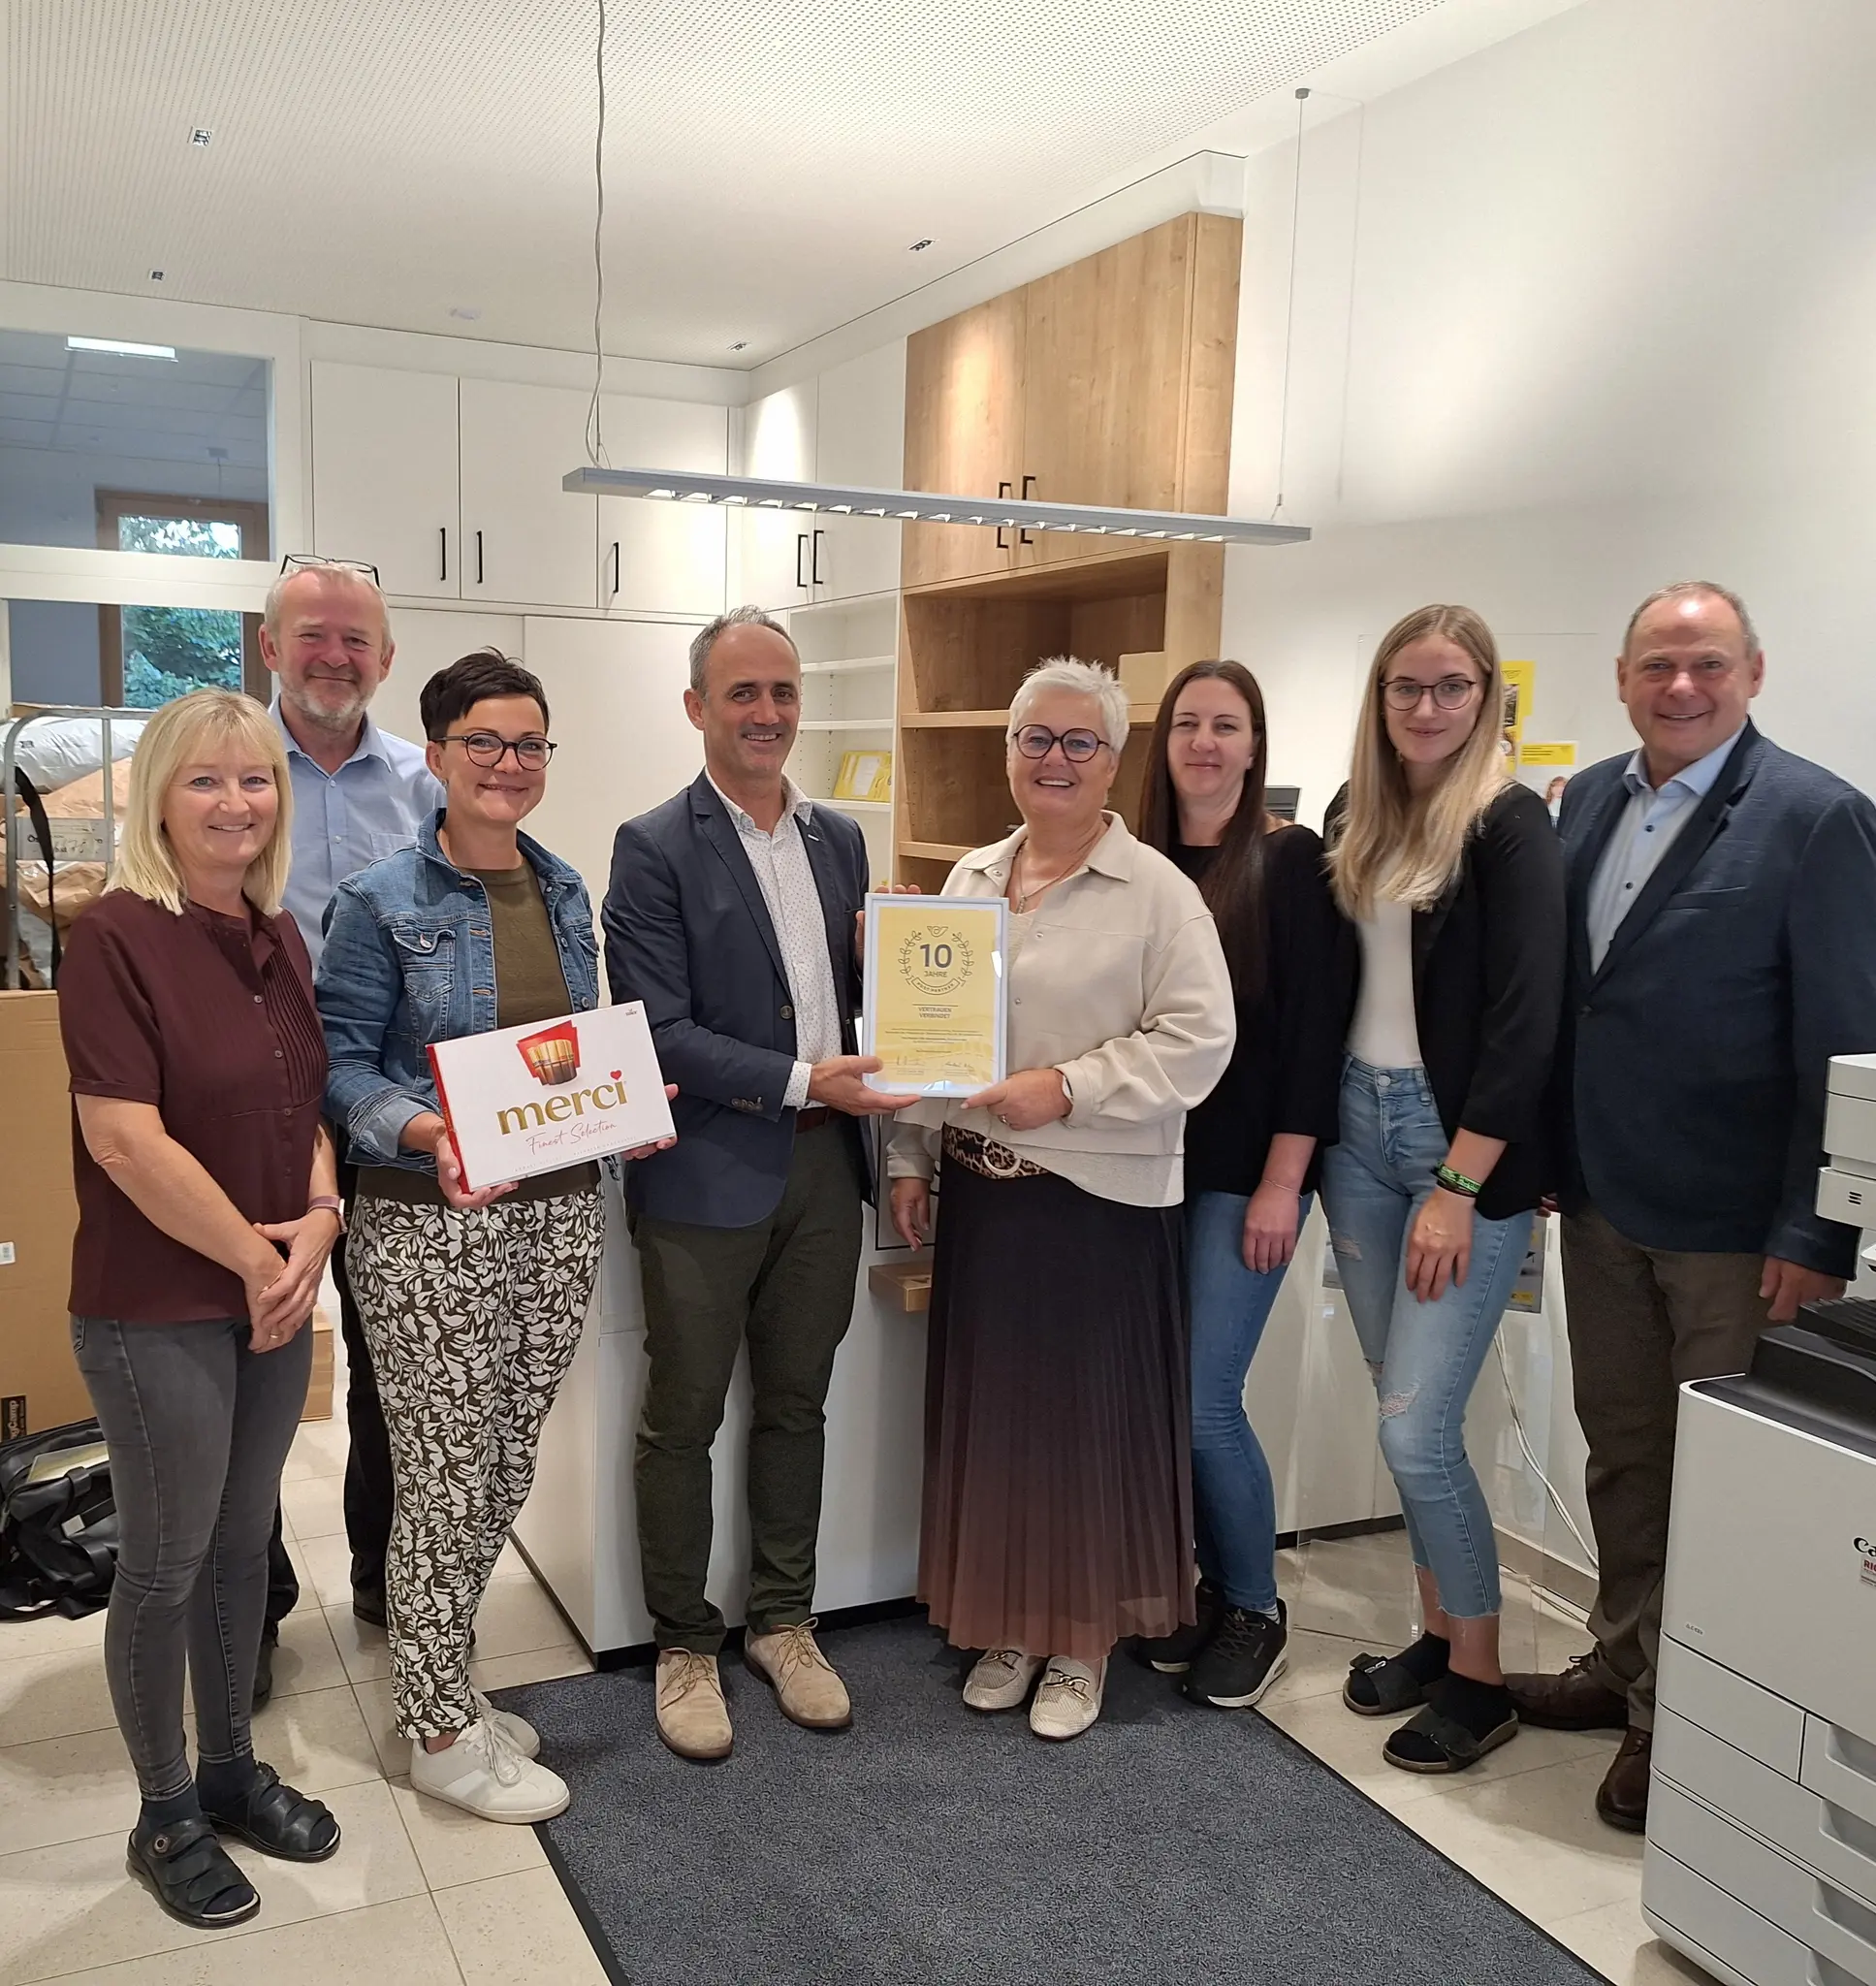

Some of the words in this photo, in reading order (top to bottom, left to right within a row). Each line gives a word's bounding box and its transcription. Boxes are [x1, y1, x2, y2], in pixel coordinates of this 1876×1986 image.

[920, 944, 952, 968] 10
[496, 1070, 627, 1136] merci
[525, 1130, 567, 1155] Finest
[570, 1120, 618, 1144] Selection
